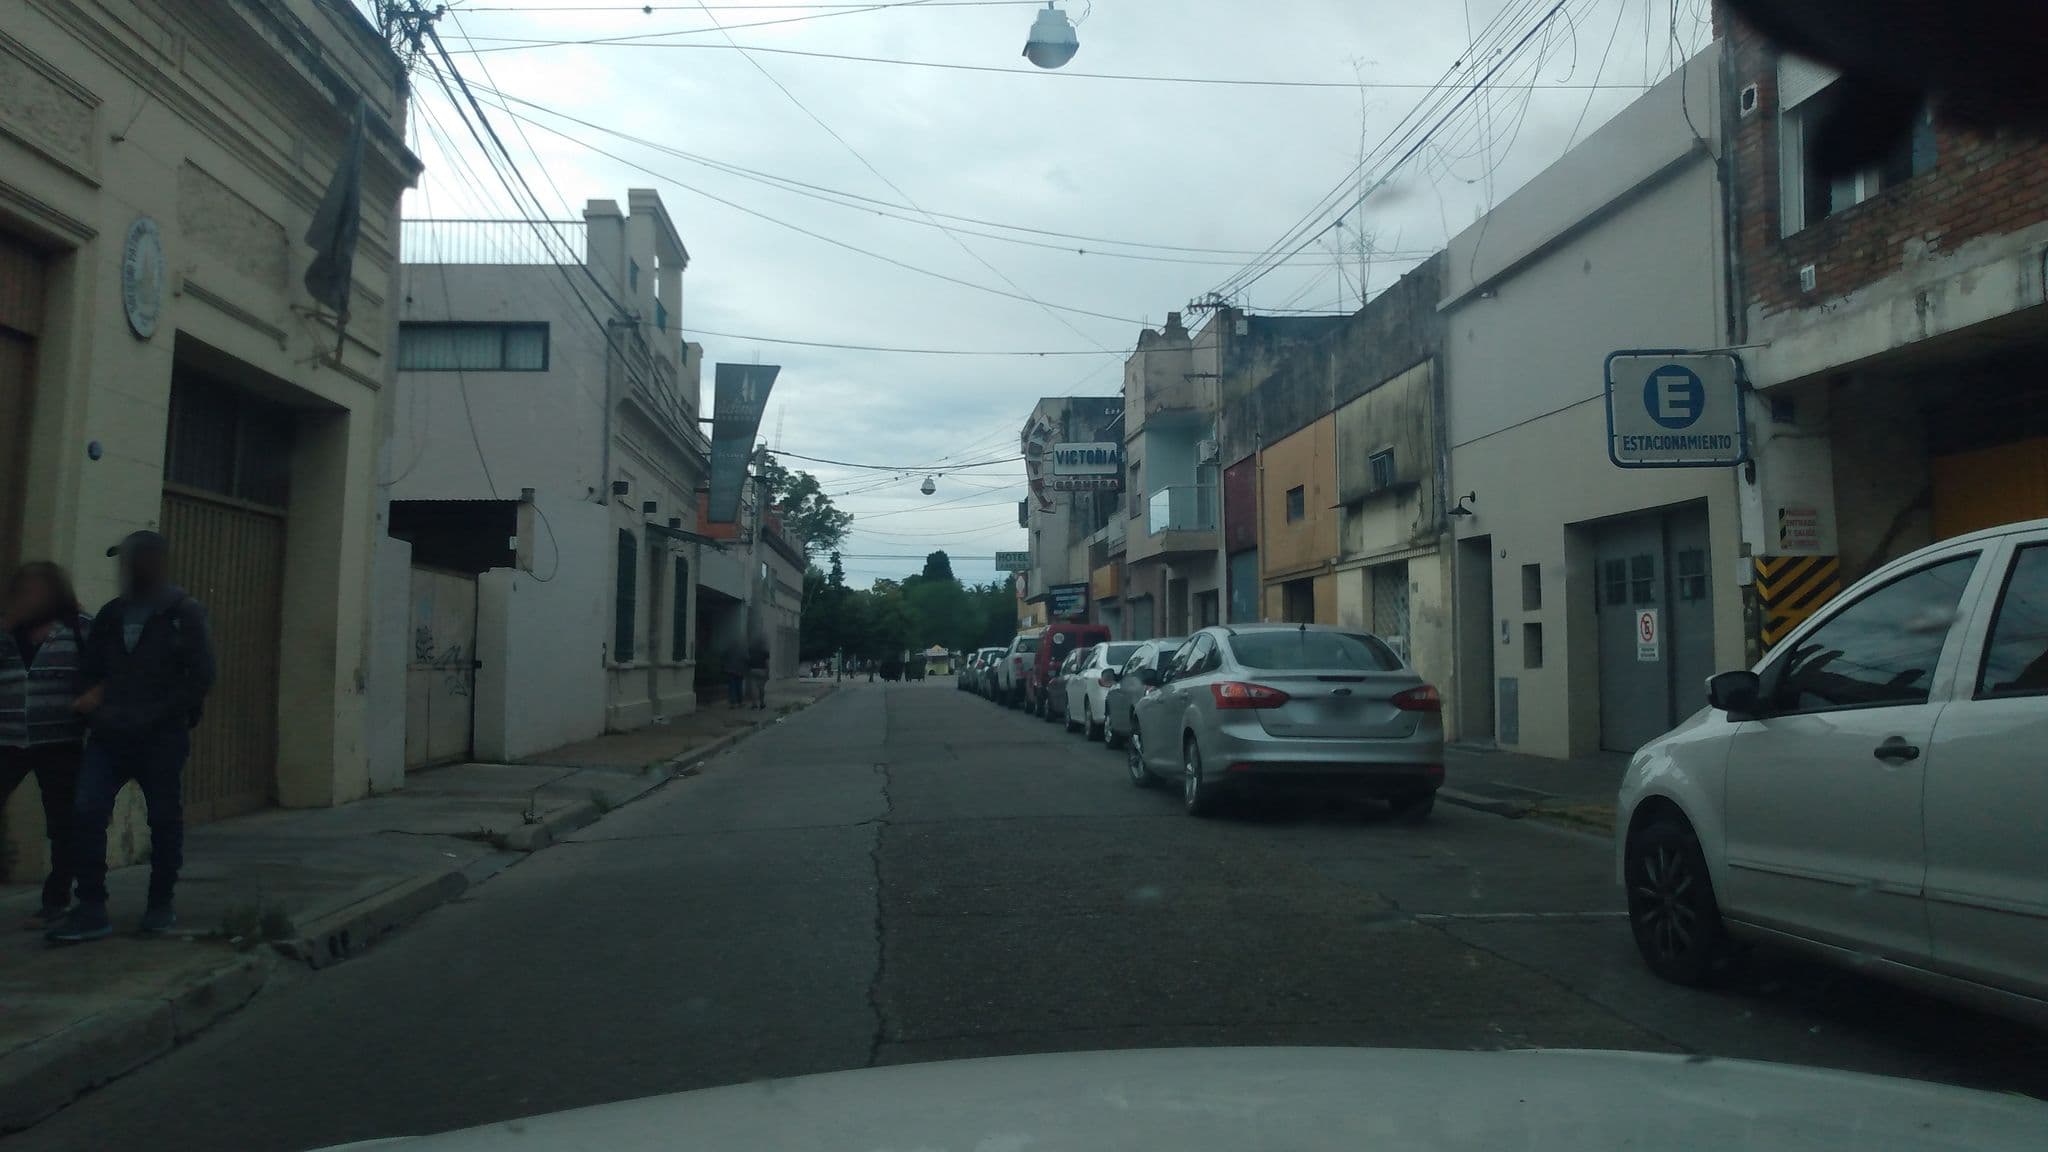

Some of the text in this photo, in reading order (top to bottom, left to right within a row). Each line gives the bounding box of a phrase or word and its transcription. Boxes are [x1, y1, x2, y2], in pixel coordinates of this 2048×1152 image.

[1656, 375, 1692, 418] E
[1622, 434, 1732, 451] ESTACIONAMIENTO
[1055, 448, 1118, 465] VICTORIA
[998, 553, 1029, 562] HOTEL
